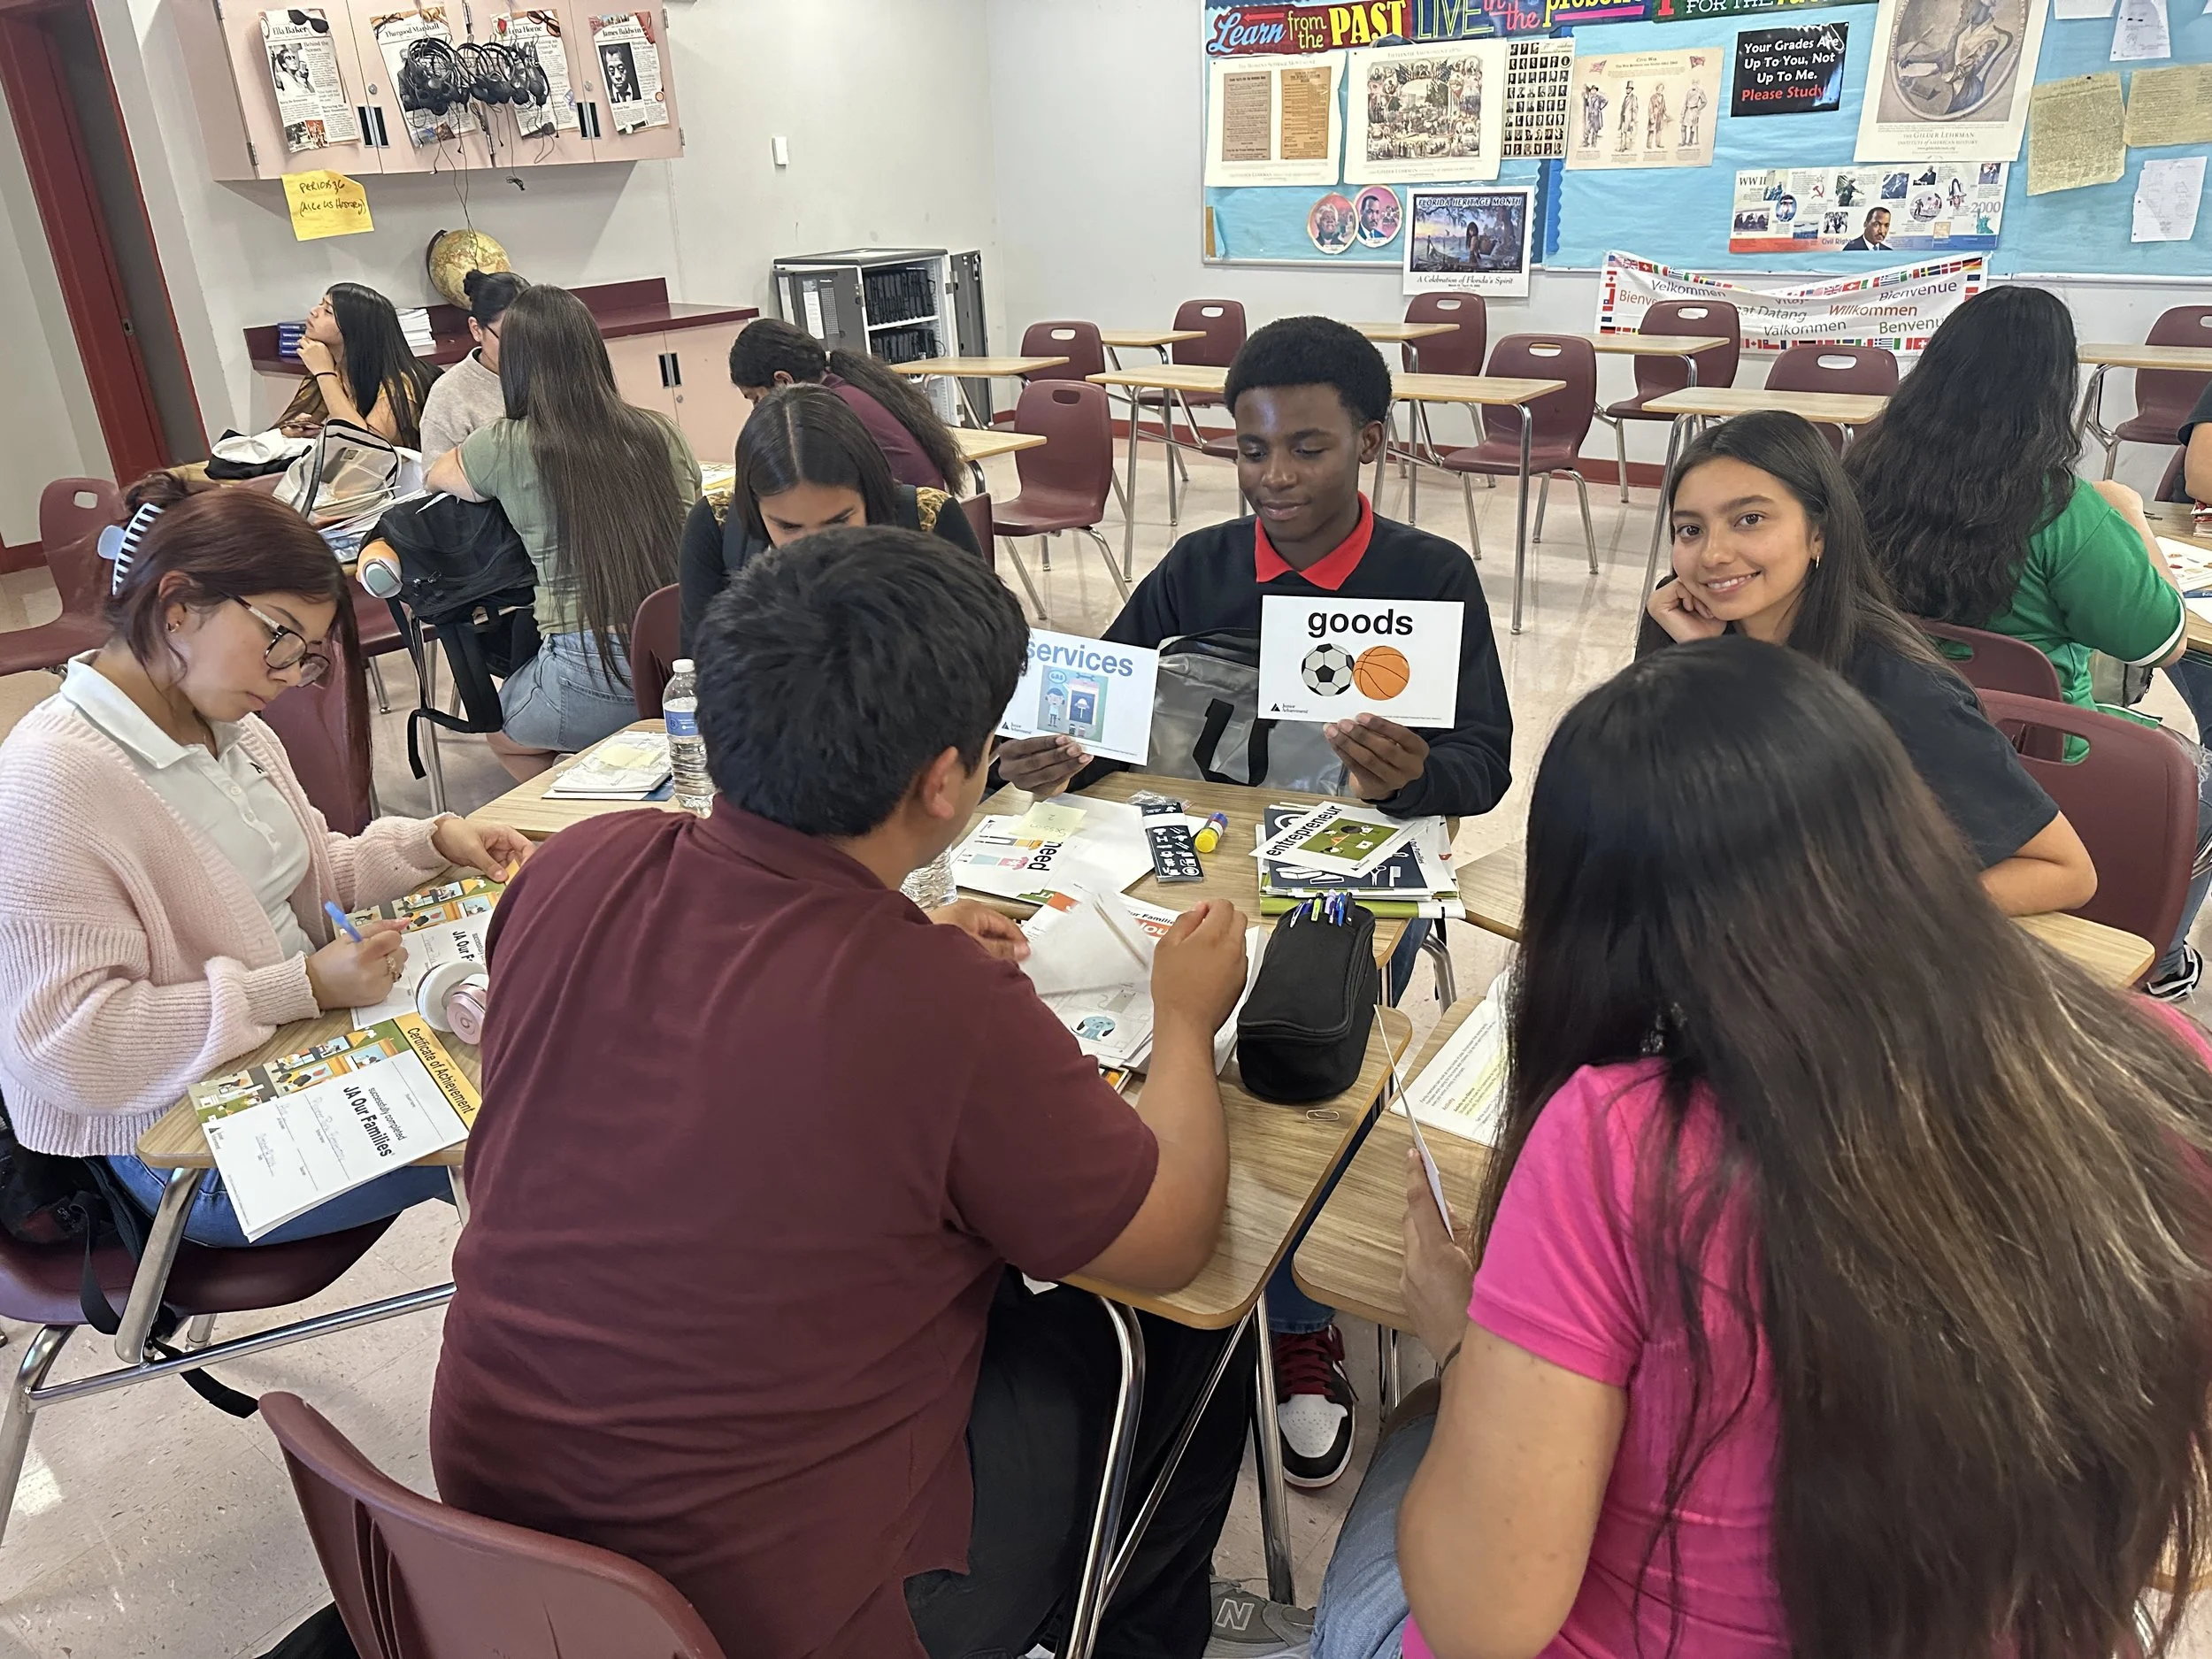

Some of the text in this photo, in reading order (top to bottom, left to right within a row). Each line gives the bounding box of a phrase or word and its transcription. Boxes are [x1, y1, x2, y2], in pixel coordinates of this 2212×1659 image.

[1287, 11, 1326, 41] from
[1329, 1, 1406, 46] PAST
[1417, 0, 1494, 40] LIVE
[1489, 11, 1540, 31] the
[273, 26, 307, 35] Ella Baker
[384, 23, 440, 38] Thurgood Marshall
[1208, 12, 1286, 53] Learn
[1298, 30, 1324, 50] the
[1744, 36, 1839, 54] Your Grades Are
[1744, 52, 1836, 73] Up To You, Not
[1757, 69, 1818, 85] Up To Me.
[1741, 84, 1825, 102] Please Study
[1418, 197, 1522, 207] FLORIDA HERITAGE MONTH
[1970, 201, 2001, 213] 2000
[1422, 275, 1457, 284] Celebration
[1458, 275, 1466, 284] of
[1466, 275, 1493, 284] Florida's
[1495, 276, 1513, 285] Spirit
[1651, 279, 1726, 298] Velkommen
[1619, 289, 1658, 305] Bienve
[1879, 281, 1957, 301] Bienvenue
[1758, 306, 1807, 323] Datang
[1829, 303, 1918, 317] Willkommen
[1763, 319, 1847, 336] Välkommen
[1879, 318, 1945, 334] Benvenu
[1308, 609, 1413, 638] goods
[1028, 640, 1133, 677] services
[1266, 805, 1343, 856] entrepreneur
[1027, 841, 1064, 872] need
[453, 930, 470, 955] JA Our
[407, 1027, 475, 1114] Certificate of Achievement
[366, 1086, 407, 1141] successfully completed
[1442, 1098, 1455, 1110] Activity
[344, 1086, 395, 1157] JA Our Families
